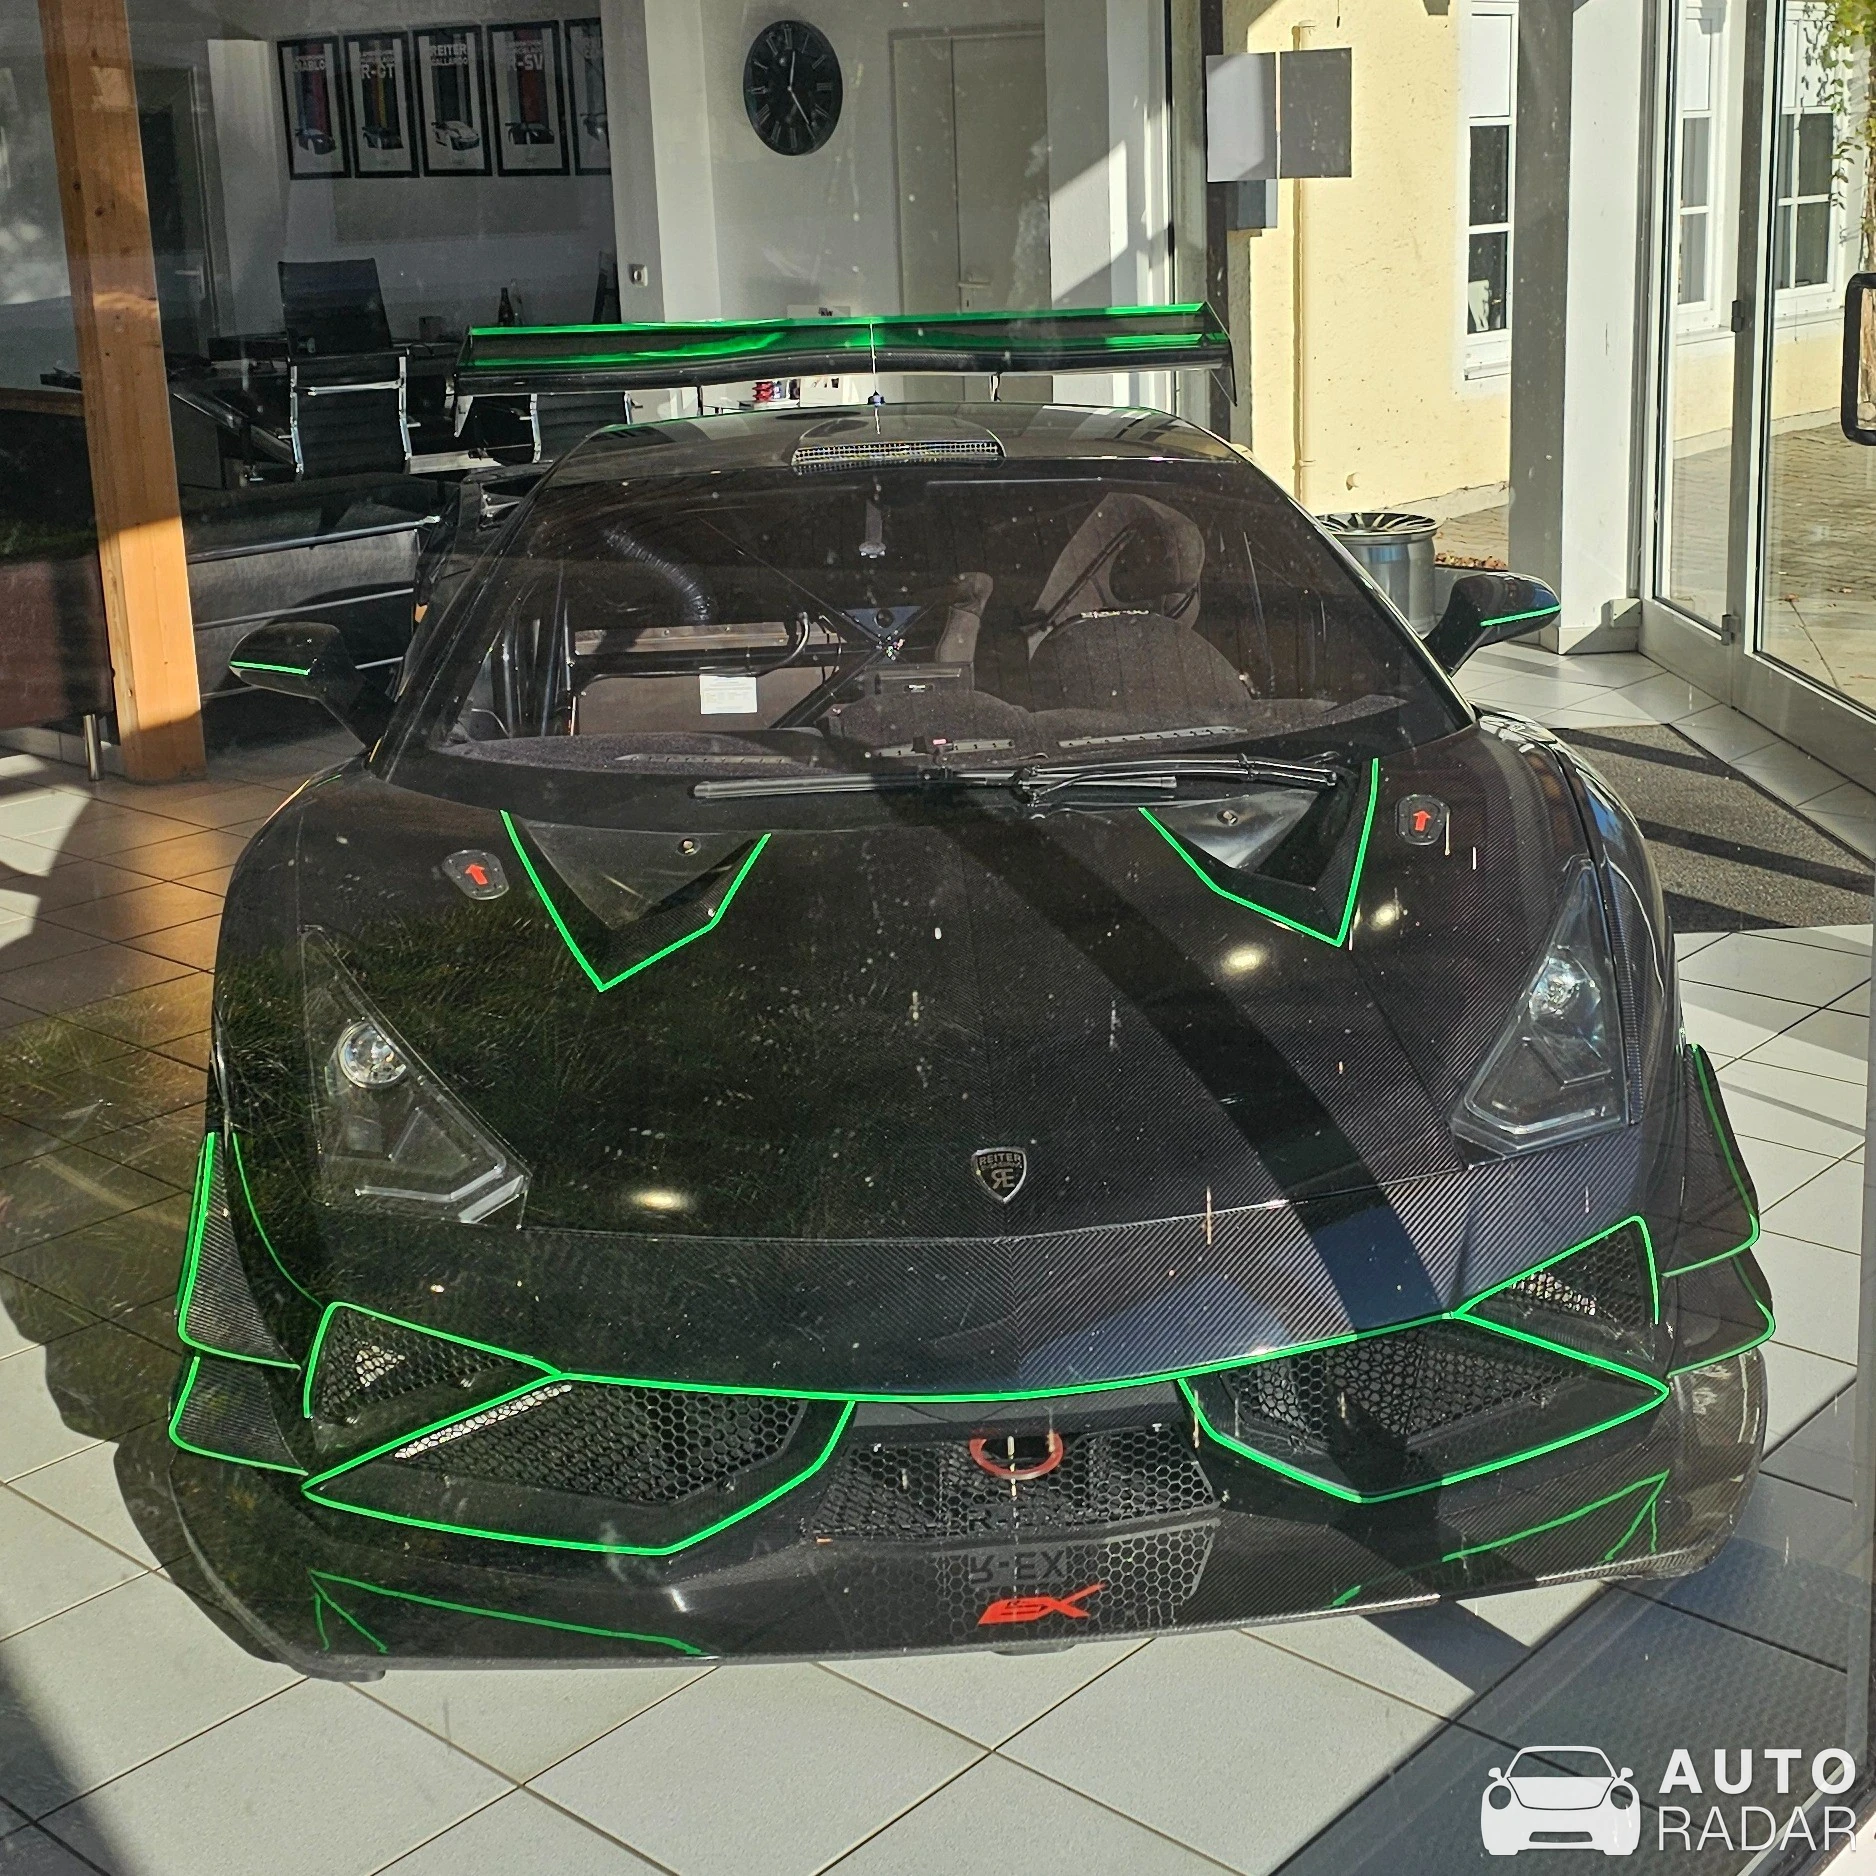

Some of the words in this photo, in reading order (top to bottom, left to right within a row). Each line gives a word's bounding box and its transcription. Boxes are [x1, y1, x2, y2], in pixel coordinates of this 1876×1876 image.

[429, 43, 467, 59] REITER
[361, 62, 396, 79] R-GT
[978, 1153, 1022, 1166] REITER
